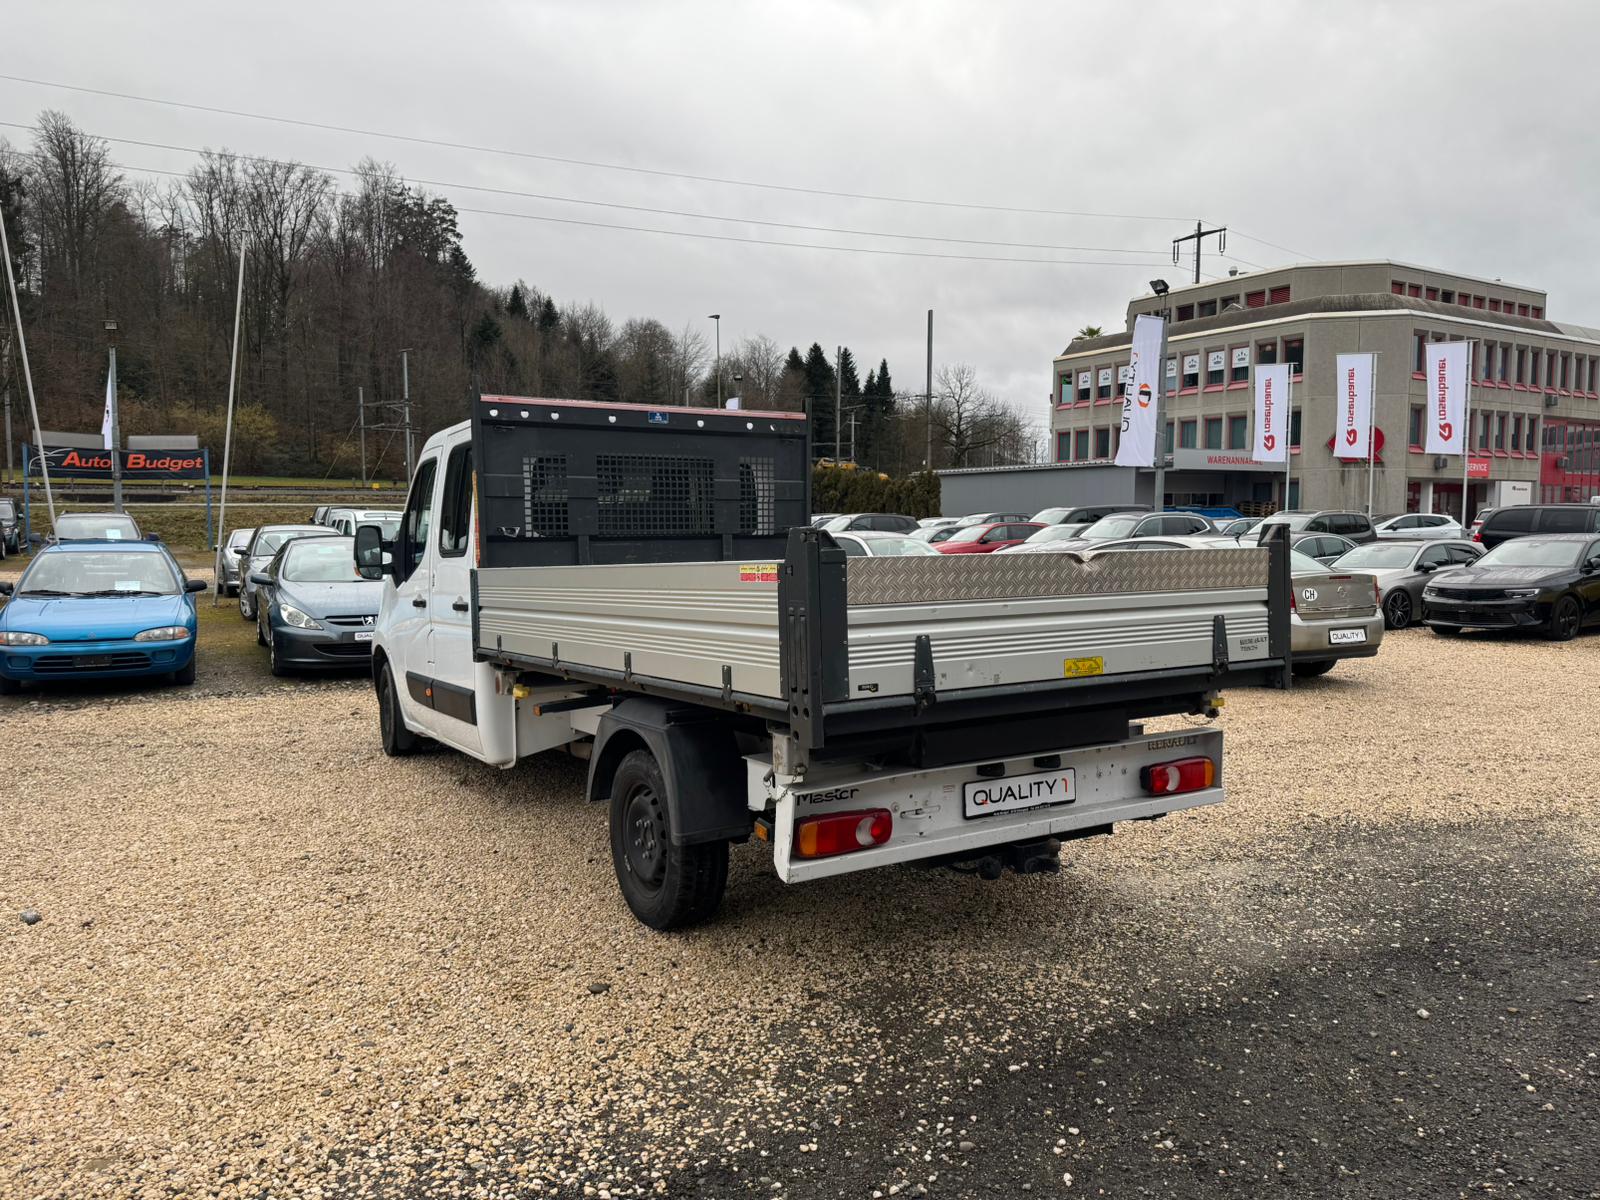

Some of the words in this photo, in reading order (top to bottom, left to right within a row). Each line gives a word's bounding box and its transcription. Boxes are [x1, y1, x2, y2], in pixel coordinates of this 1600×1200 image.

[61, 451, 112, 467] Auto
[126, 453, 204, 472] Budget
[1304, 589, 1315, 600] CH
[1332, 632, 1359, 640] QUALITY
[973, 779, 1057, 806] QUALITY
[1061, 777, 1068, 793] 1
